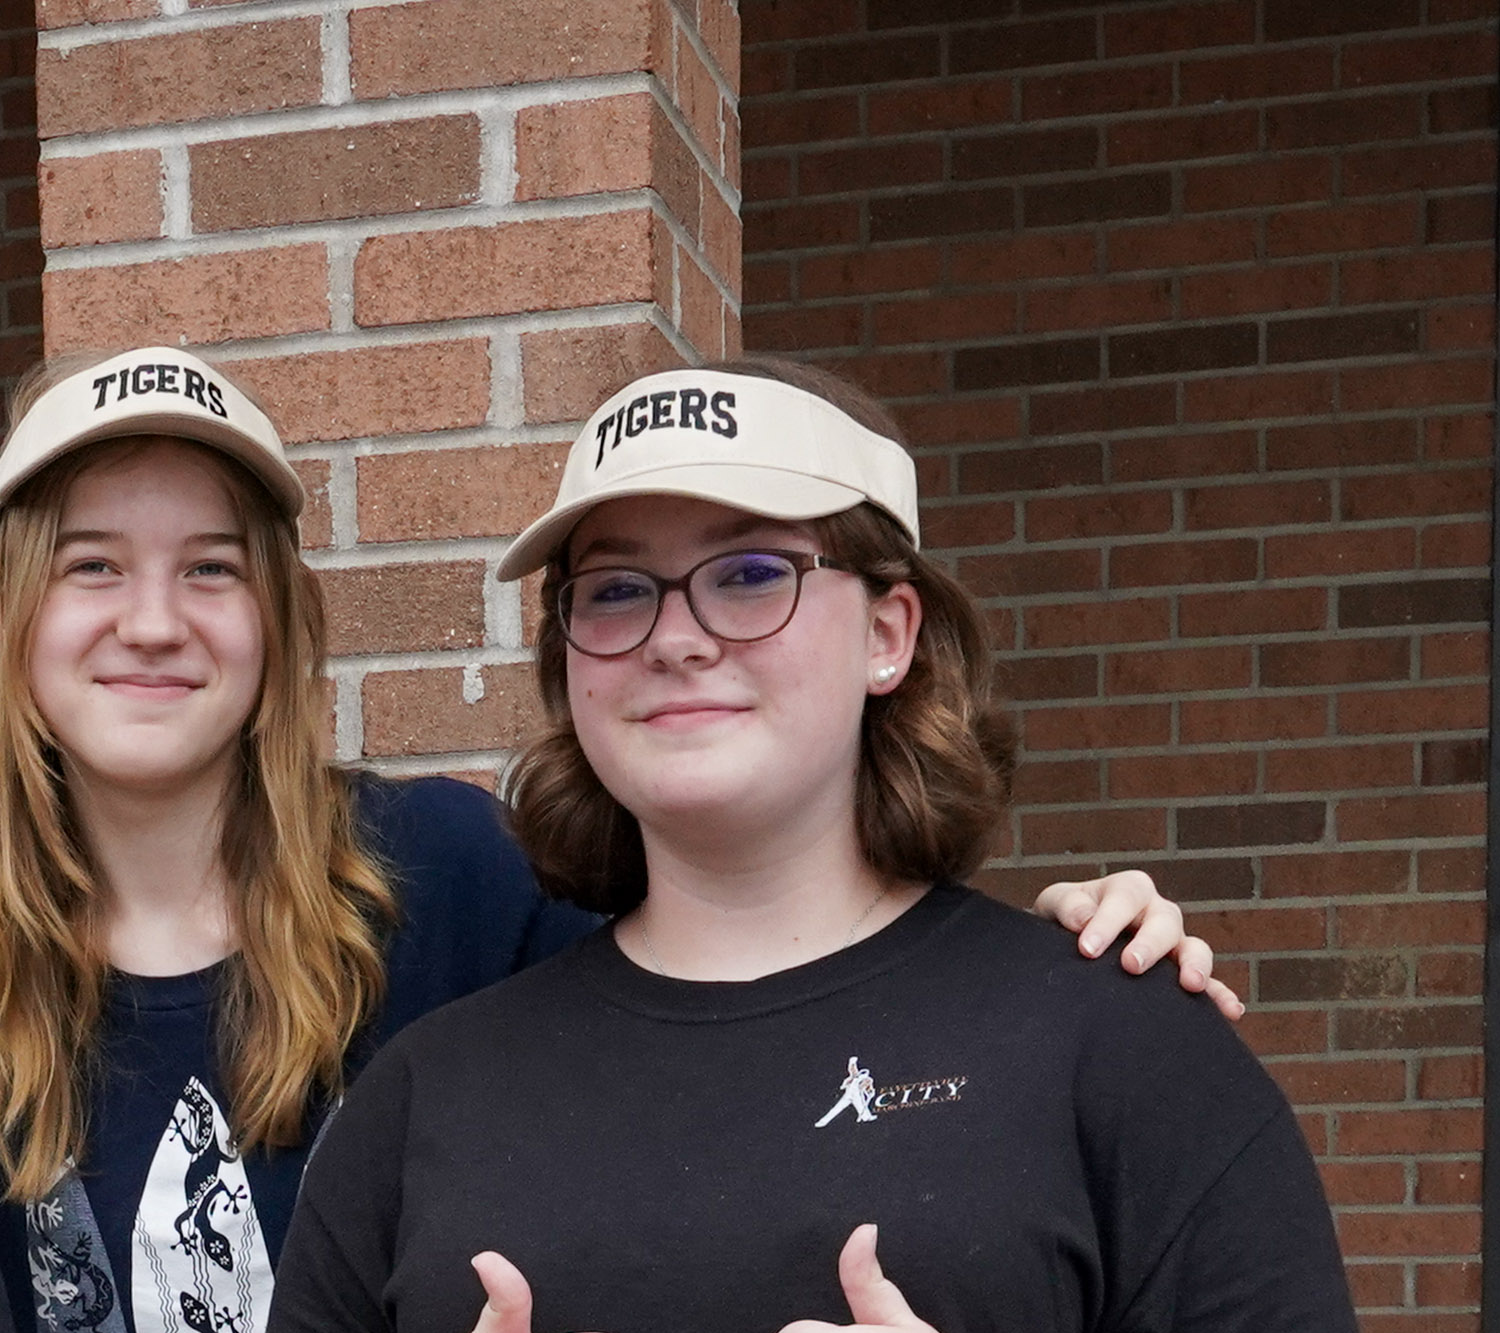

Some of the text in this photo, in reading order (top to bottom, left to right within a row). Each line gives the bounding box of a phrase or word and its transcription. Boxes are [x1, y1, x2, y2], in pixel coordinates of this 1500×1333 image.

[91, 361, 230, 420] TIGERS
[594, 389, 738, 467] TIGERS
[874, 1081, 967, 1108] CITY
